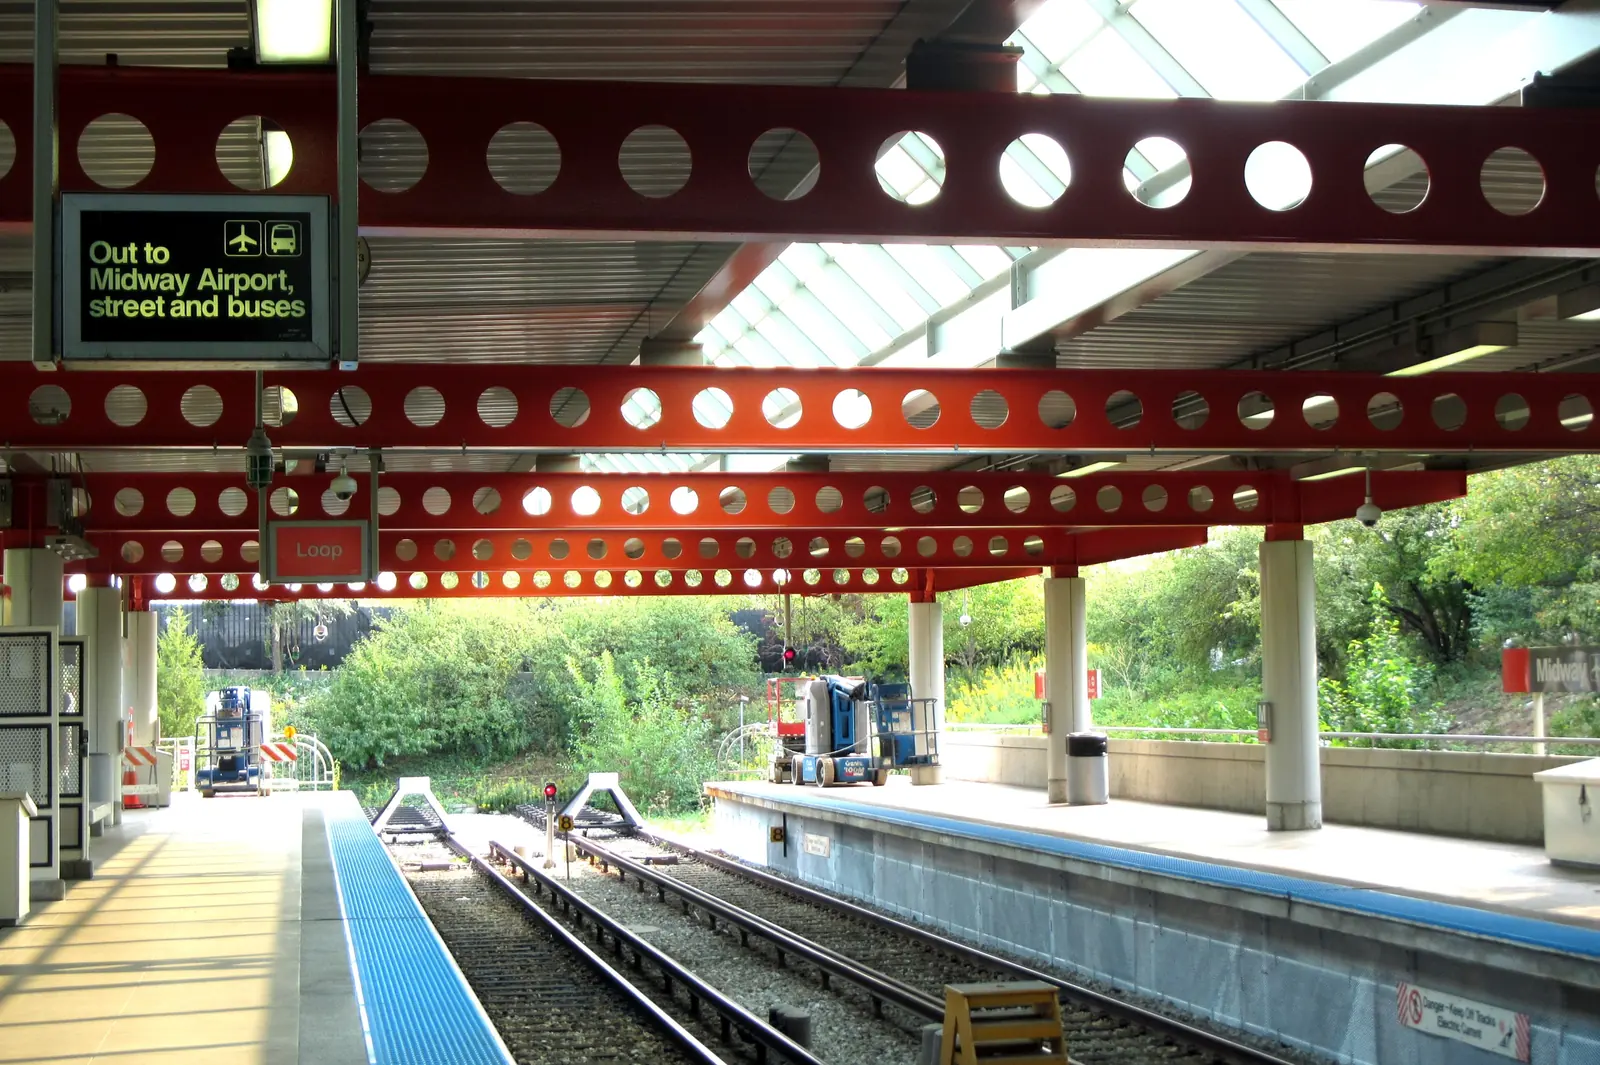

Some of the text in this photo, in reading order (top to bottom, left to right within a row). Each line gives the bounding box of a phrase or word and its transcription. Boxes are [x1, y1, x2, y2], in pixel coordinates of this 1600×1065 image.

[89, 240, 170, 265] Out to
[89, 267, 294, 296] Midway Airport,
[89, 294, 306, 317] street and buses
[296, 541, 343, 561] Loop
[1536, 656, 1588, 688] Midway
[561, 816, 572, 829] 8
[773, 828, 784, 841] 8
